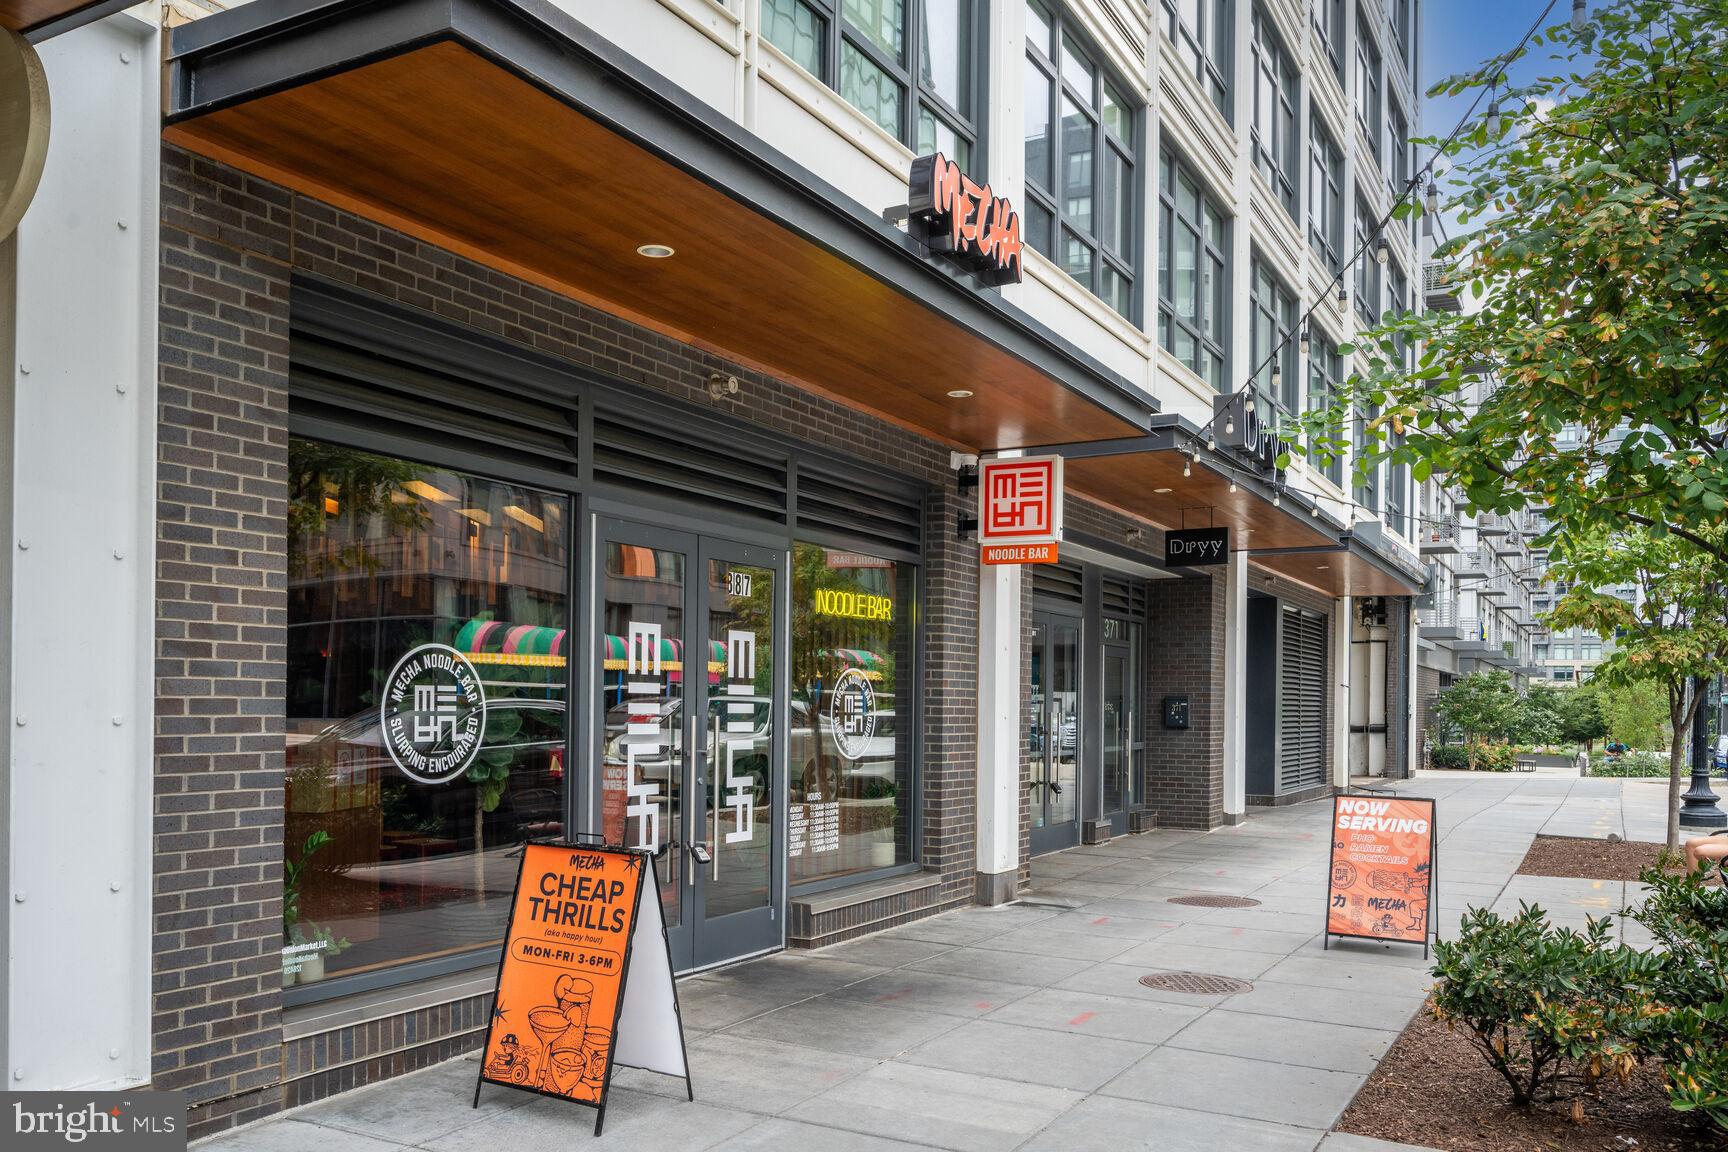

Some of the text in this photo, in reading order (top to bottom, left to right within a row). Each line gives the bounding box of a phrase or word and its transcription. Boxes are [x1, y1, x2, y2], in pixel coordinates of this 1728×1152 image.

[933, 151, 1023, 283] MECHA
[988, 547, 1049, 561] NOODLE BAR
[1169, 539, 1223, 557] Dryy
[815, 589, 892, 621] NOODLE BAR
[1104, 619, 1119, 639] 371
[390, 653, 478, 703] MECHA NOODLE BAR
[390, 717, 427, 771] SLURPING
[428, 717, 478, 773] ENCOURAGED
[807, 791, 822, 801] HOURS
[1338, 799, 1390, 816] NOW
[1337, 815, 1428, 834] SERVING
[1350, 834, 1376, 843] PHO
[1349, 842, 1389, 854] RAMEN
[569, 854, 606, 872] MECHA
[1349, 852, 1409, 866] COCKTAILS
[540, 872, 625, 905] CHEAP
[1332, 894, 1346, 908] 力
[1367, 896, 1407, 911] MECHA
[529, 896, 626, 934] THRILLS
[544, 928, 603, 945] (aka happy hour)
[523, 945, 613, 969] MON-FRI 3-6PM
